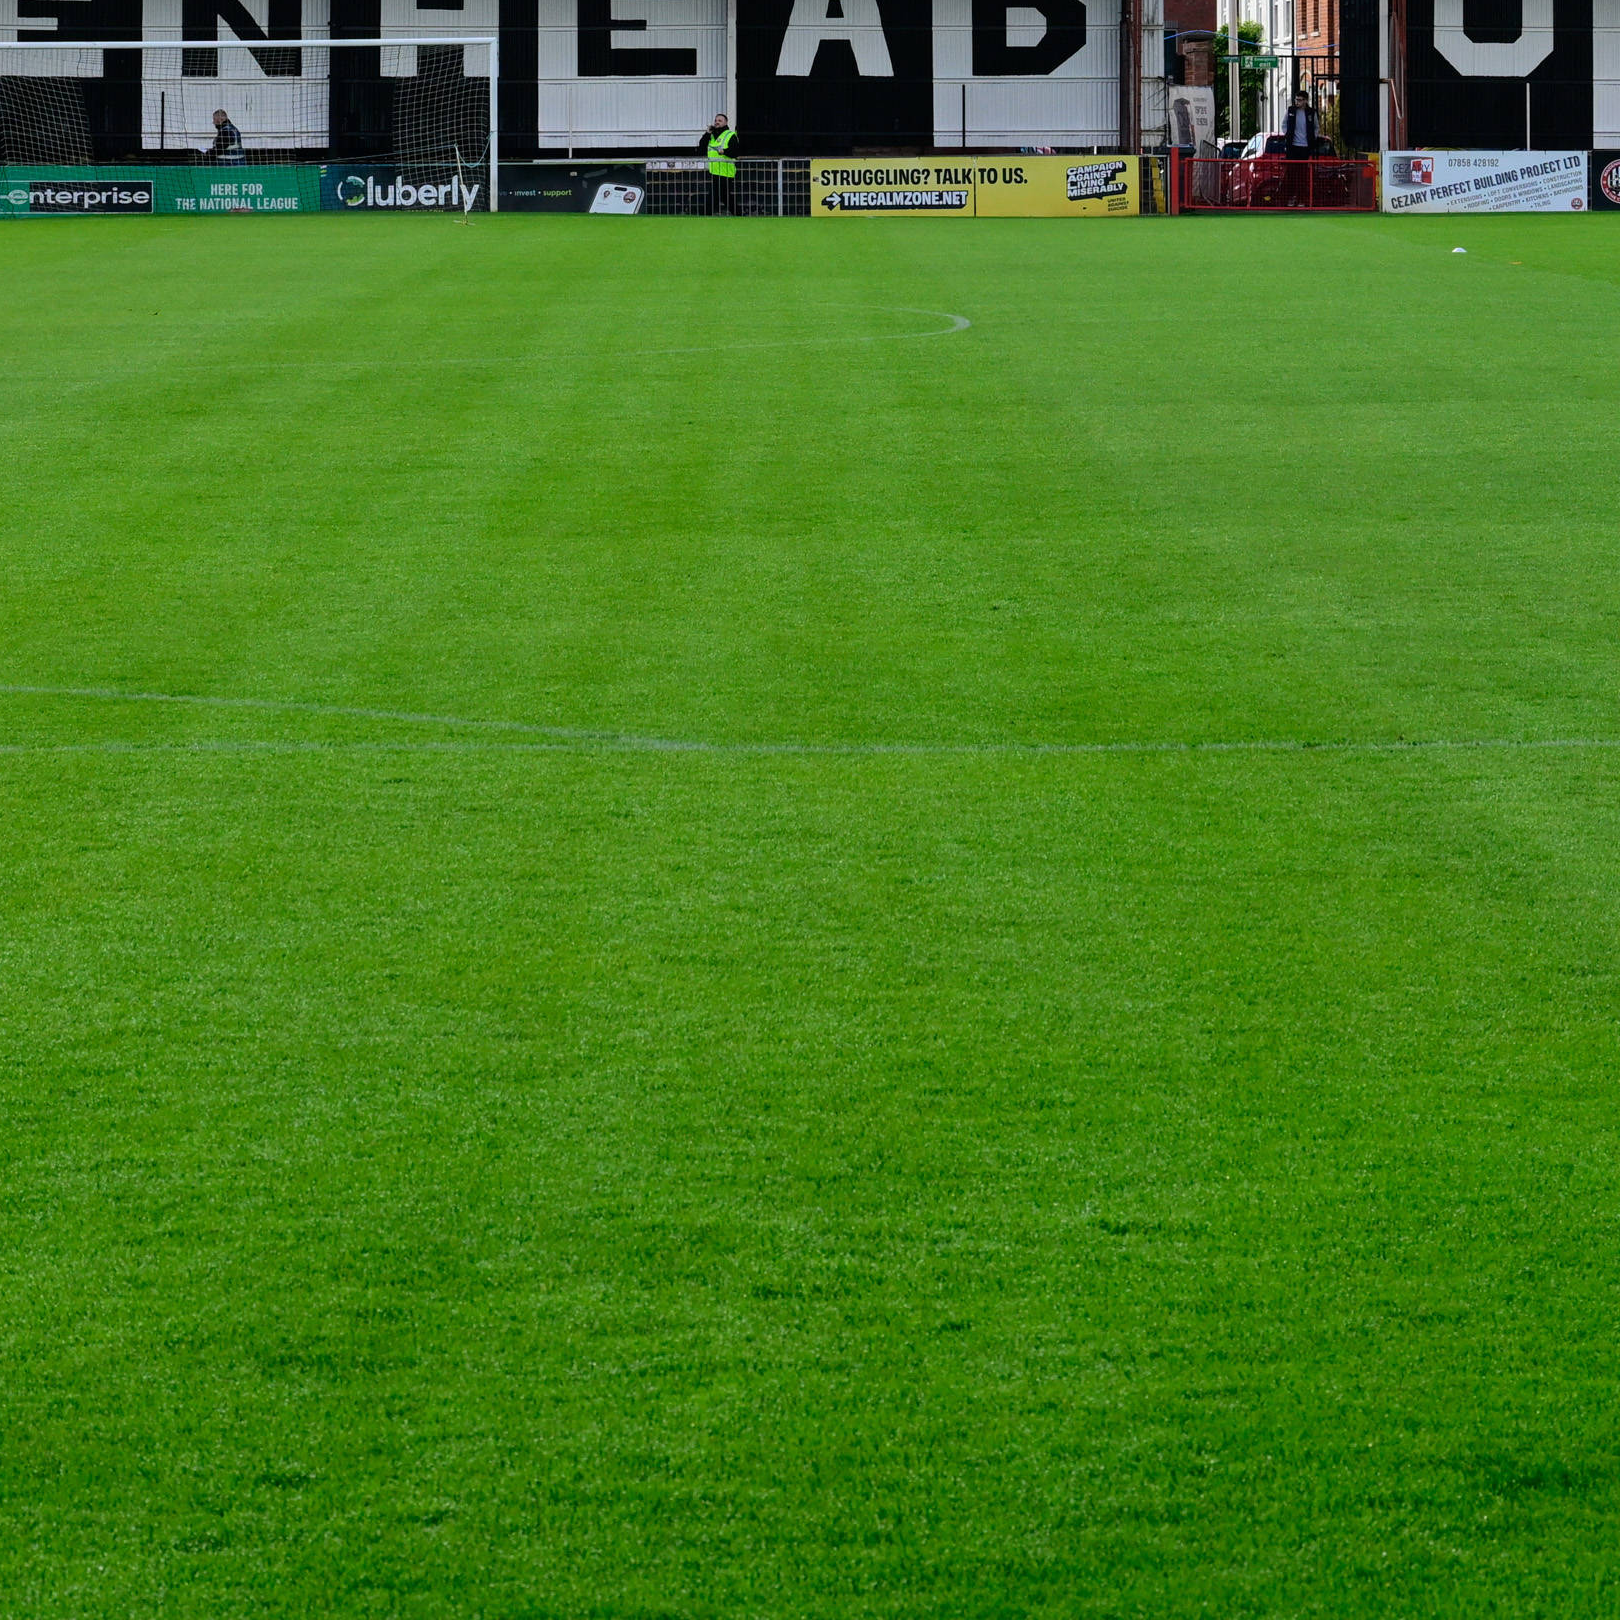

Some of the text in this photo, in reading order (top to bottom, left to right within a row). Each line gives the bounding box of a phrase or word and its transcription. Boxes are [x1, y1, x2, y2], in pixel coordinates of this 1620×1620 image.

[1067, 161, 1123, 175] CAMPAIGN
[1448, 158, 1499, 167] 07858 428192
[820, 167, 1028, 186] STRUGGLING? TALK TO US.
[1067, 170, 1112, 182] AGAINST
[1391, 155, 1581, 209] CEZARY PERFECT BUILDING PROJECT LTD
[210, 183, 263, 196] HERE FOR
[1067, 178, 1105, 189] LIVING
[1067, 183, 1124, 197] MISERABLY
[2, 186, 151, 208] enterprise
[543, 189, 572, 197] support
[843, 191, 968, 206] THECALMZONE.NET
[175, 197, 299, 210] THE NATIONAL LEAGUE
